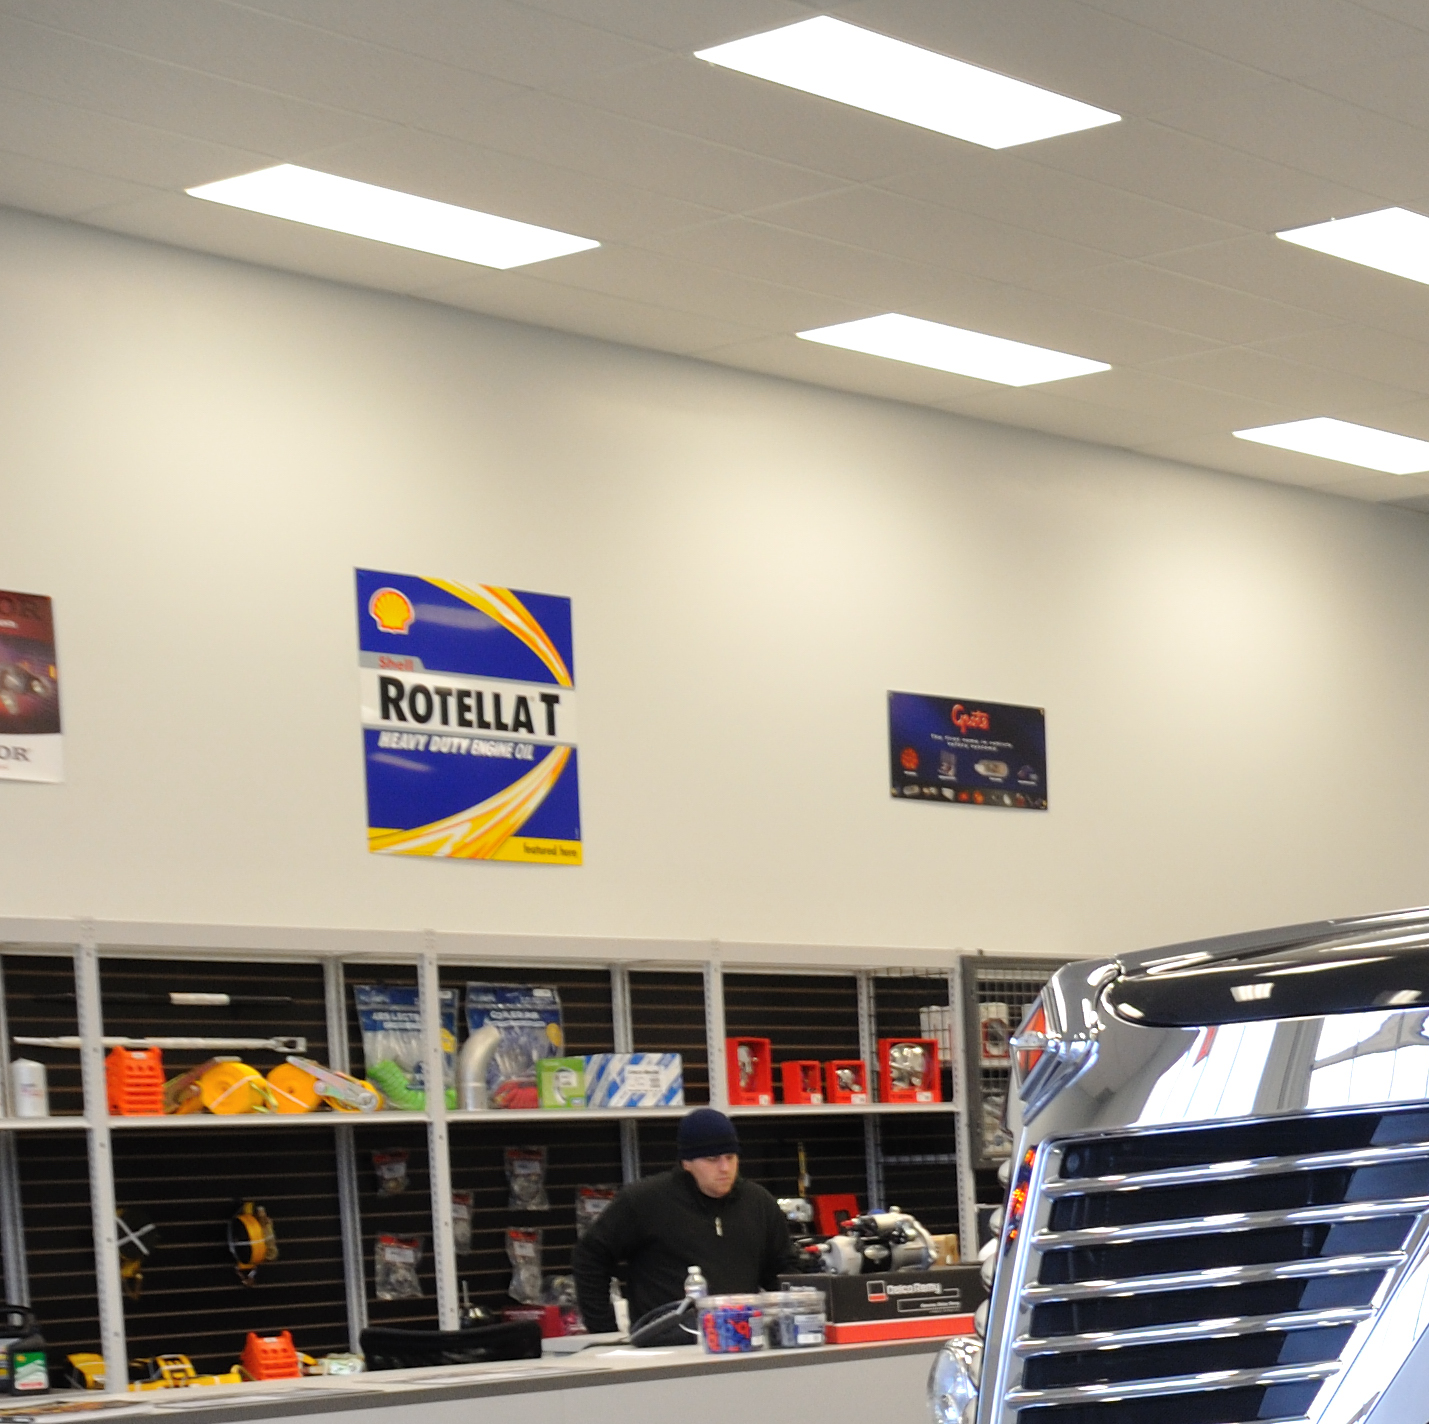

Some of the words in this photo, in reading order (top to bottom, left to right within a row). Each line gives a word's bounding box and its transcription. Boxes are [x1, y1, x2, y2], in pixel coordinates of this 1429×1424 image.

[378, 655, 414, 671] Shell
[378, 675, 535, 735] ROTELLA
[539, 692, 560, 736] T
[0, 744, 31, 762] OR
[378, 731, 429, 751] HEAVY
[429, 735, 470, 755] DUTY
[470, 739, 514, 759] ENGINE
[514, 742, 535, 761] OIL
